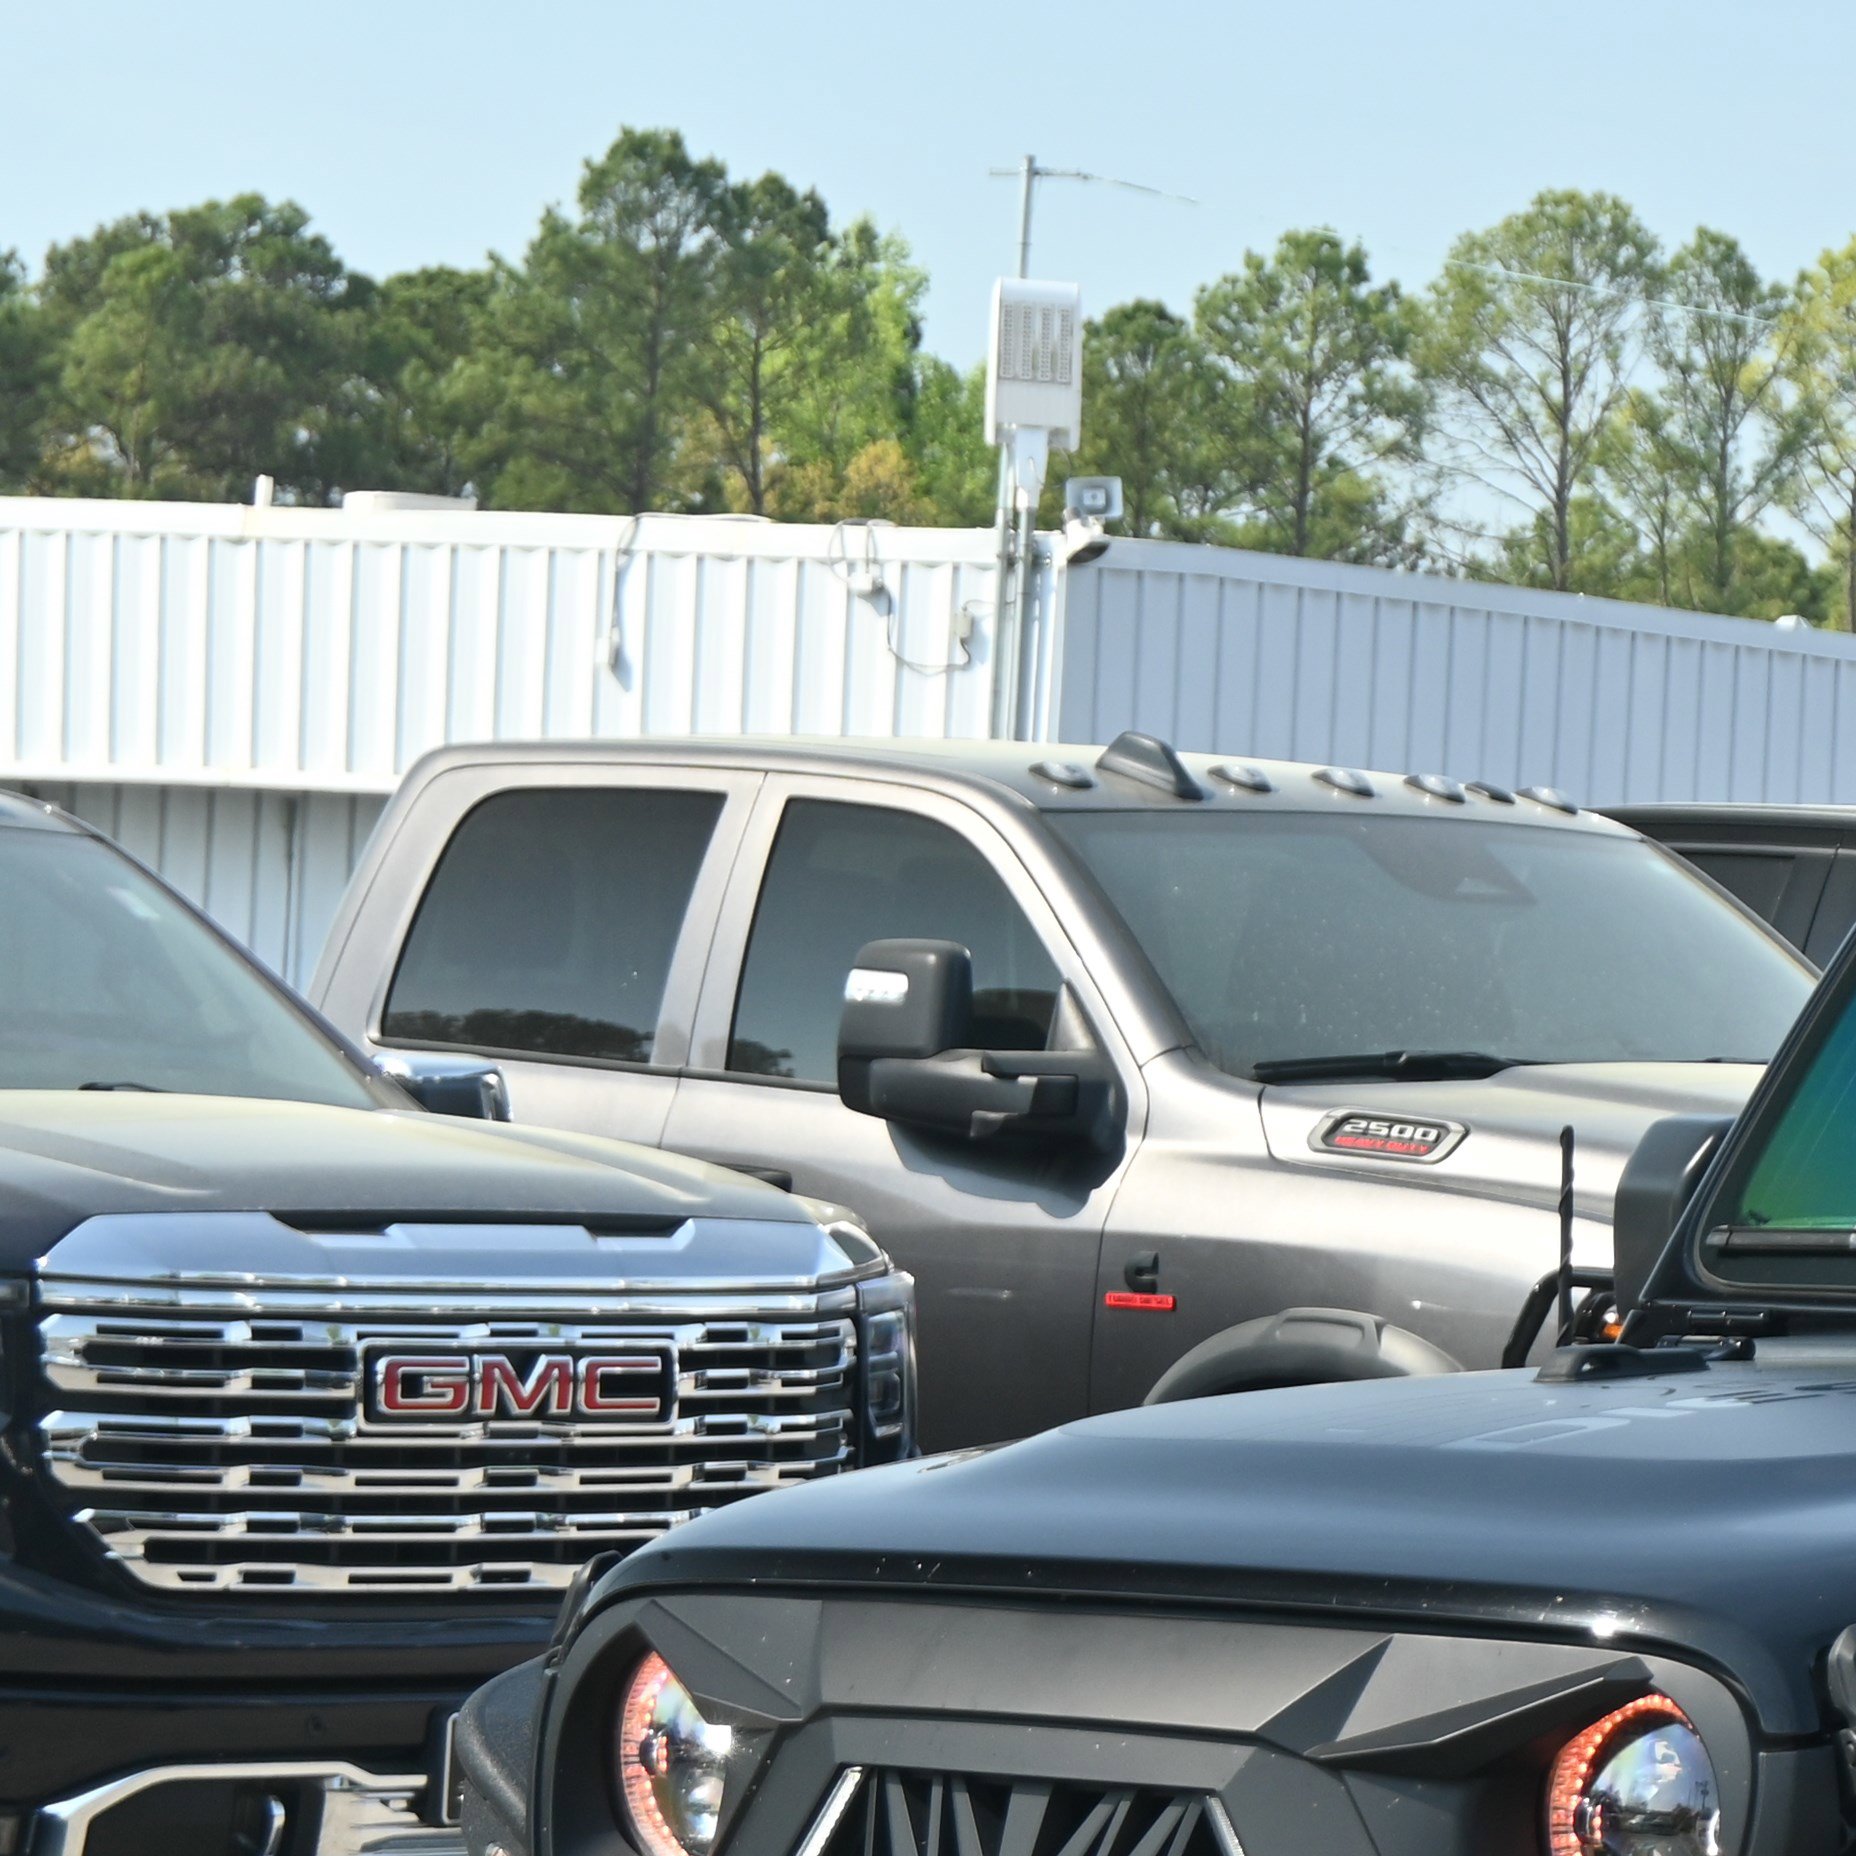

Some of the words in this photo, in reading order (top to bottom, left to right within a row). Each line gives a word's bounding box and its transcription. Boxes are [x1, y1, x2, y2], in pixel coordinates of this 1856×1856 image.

[1342, 1118, 1438, 1142] 2500
[1333, 1135, 1385, 1150] HEAVY
[377, 1354, 662, 1415] GMC
